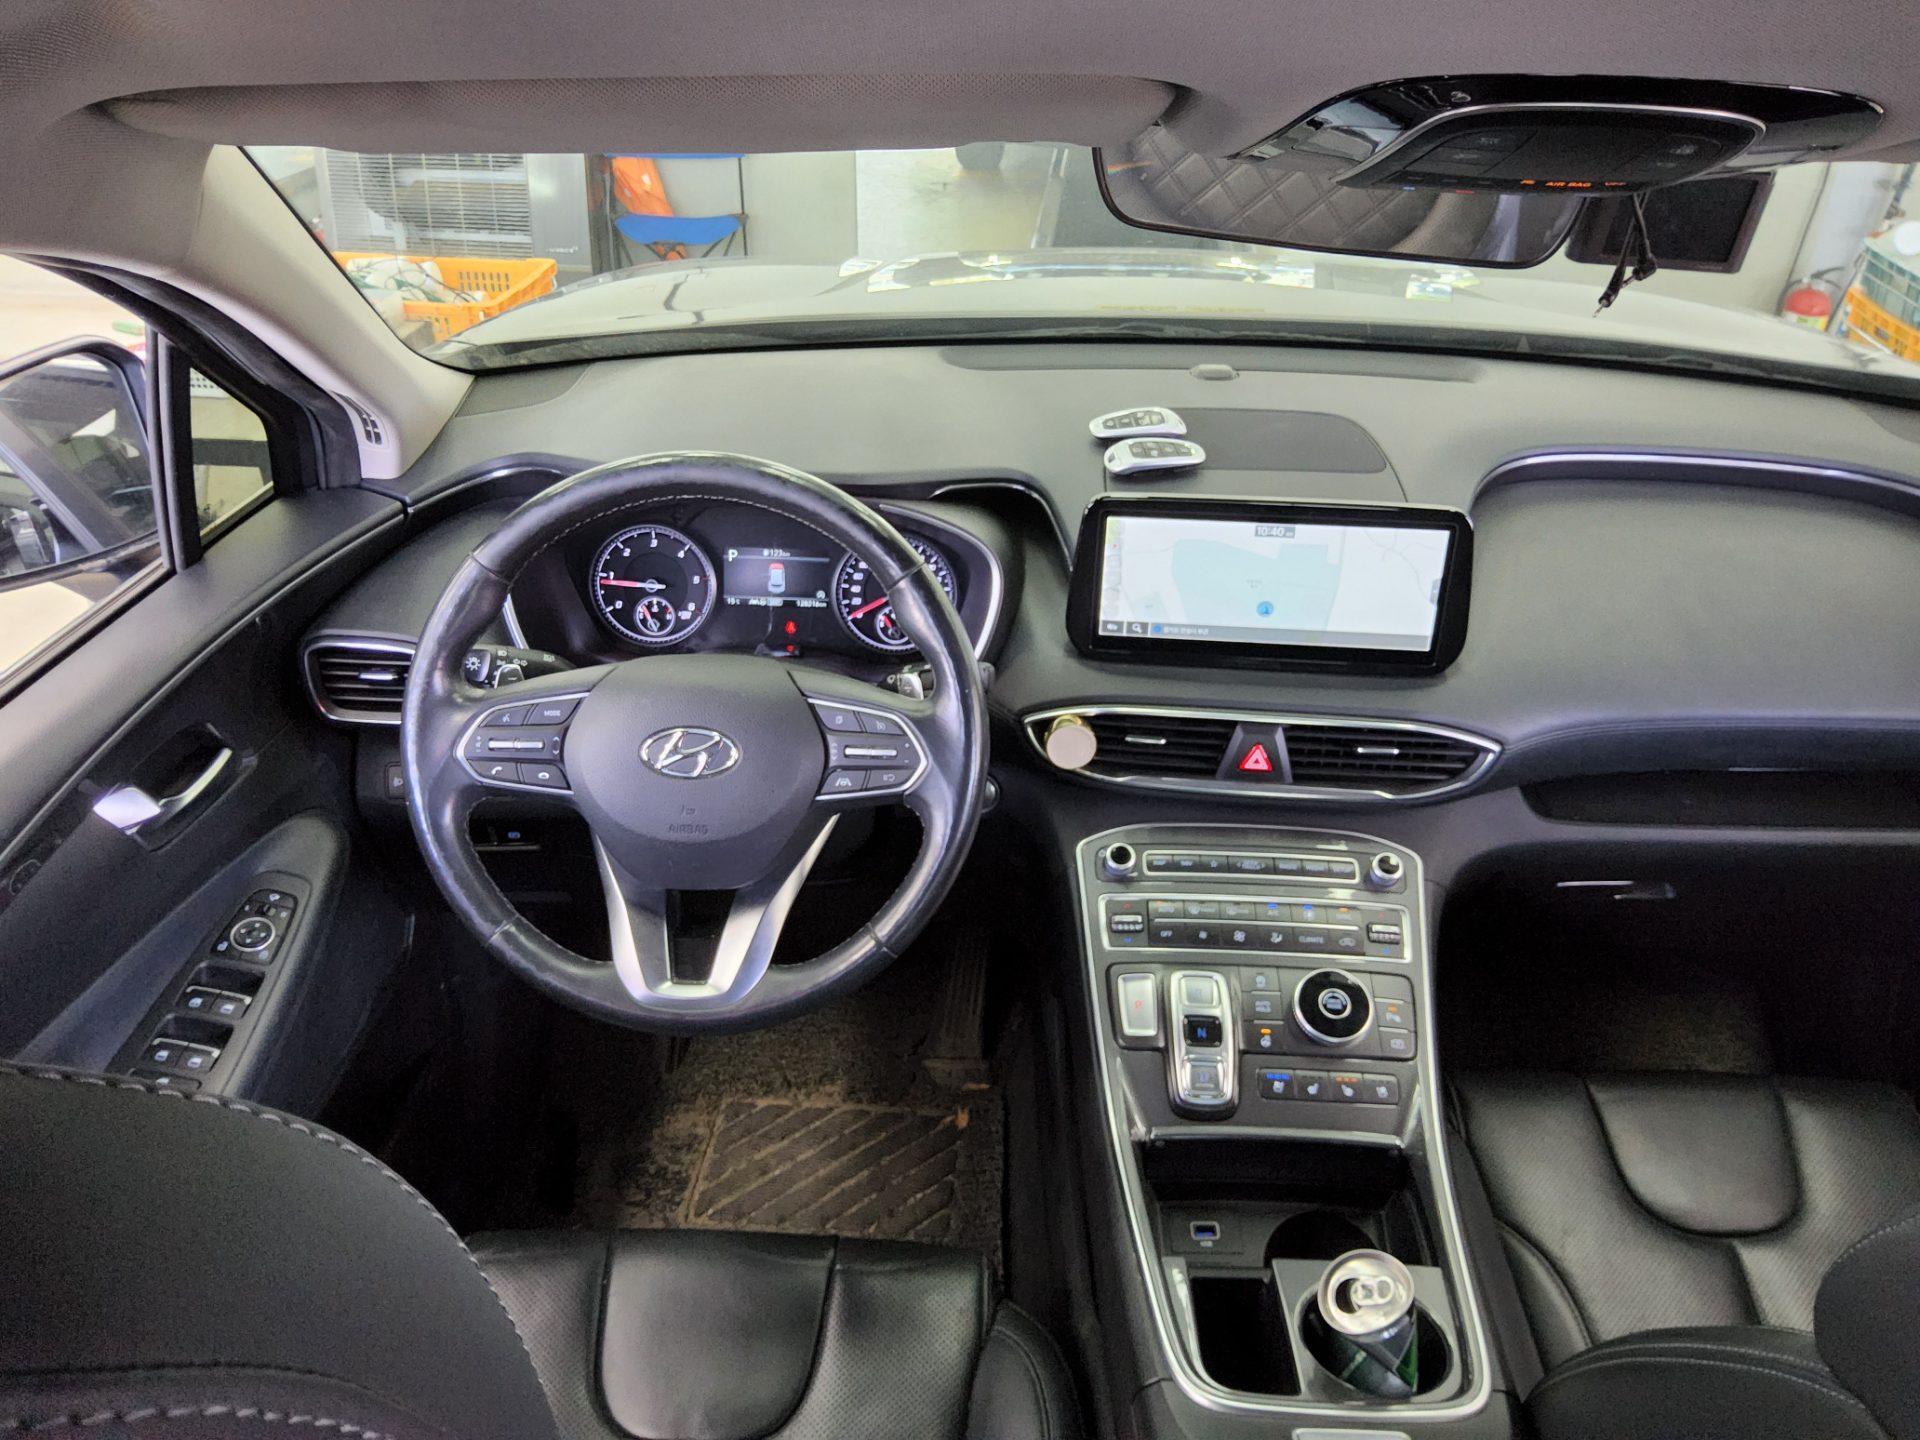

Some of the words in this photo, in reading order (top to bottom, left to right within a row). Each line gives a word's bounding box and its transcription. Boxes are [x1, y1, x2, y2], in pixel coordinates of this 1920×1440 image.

[1567, 181, 1592, 189] BAG
[1257, 526, 1285, 537] 10:40
[728, 549, 738, 562] P
[544, 709, 561, 717] MODE
[668, 823, 709, 835] AIRBAG
